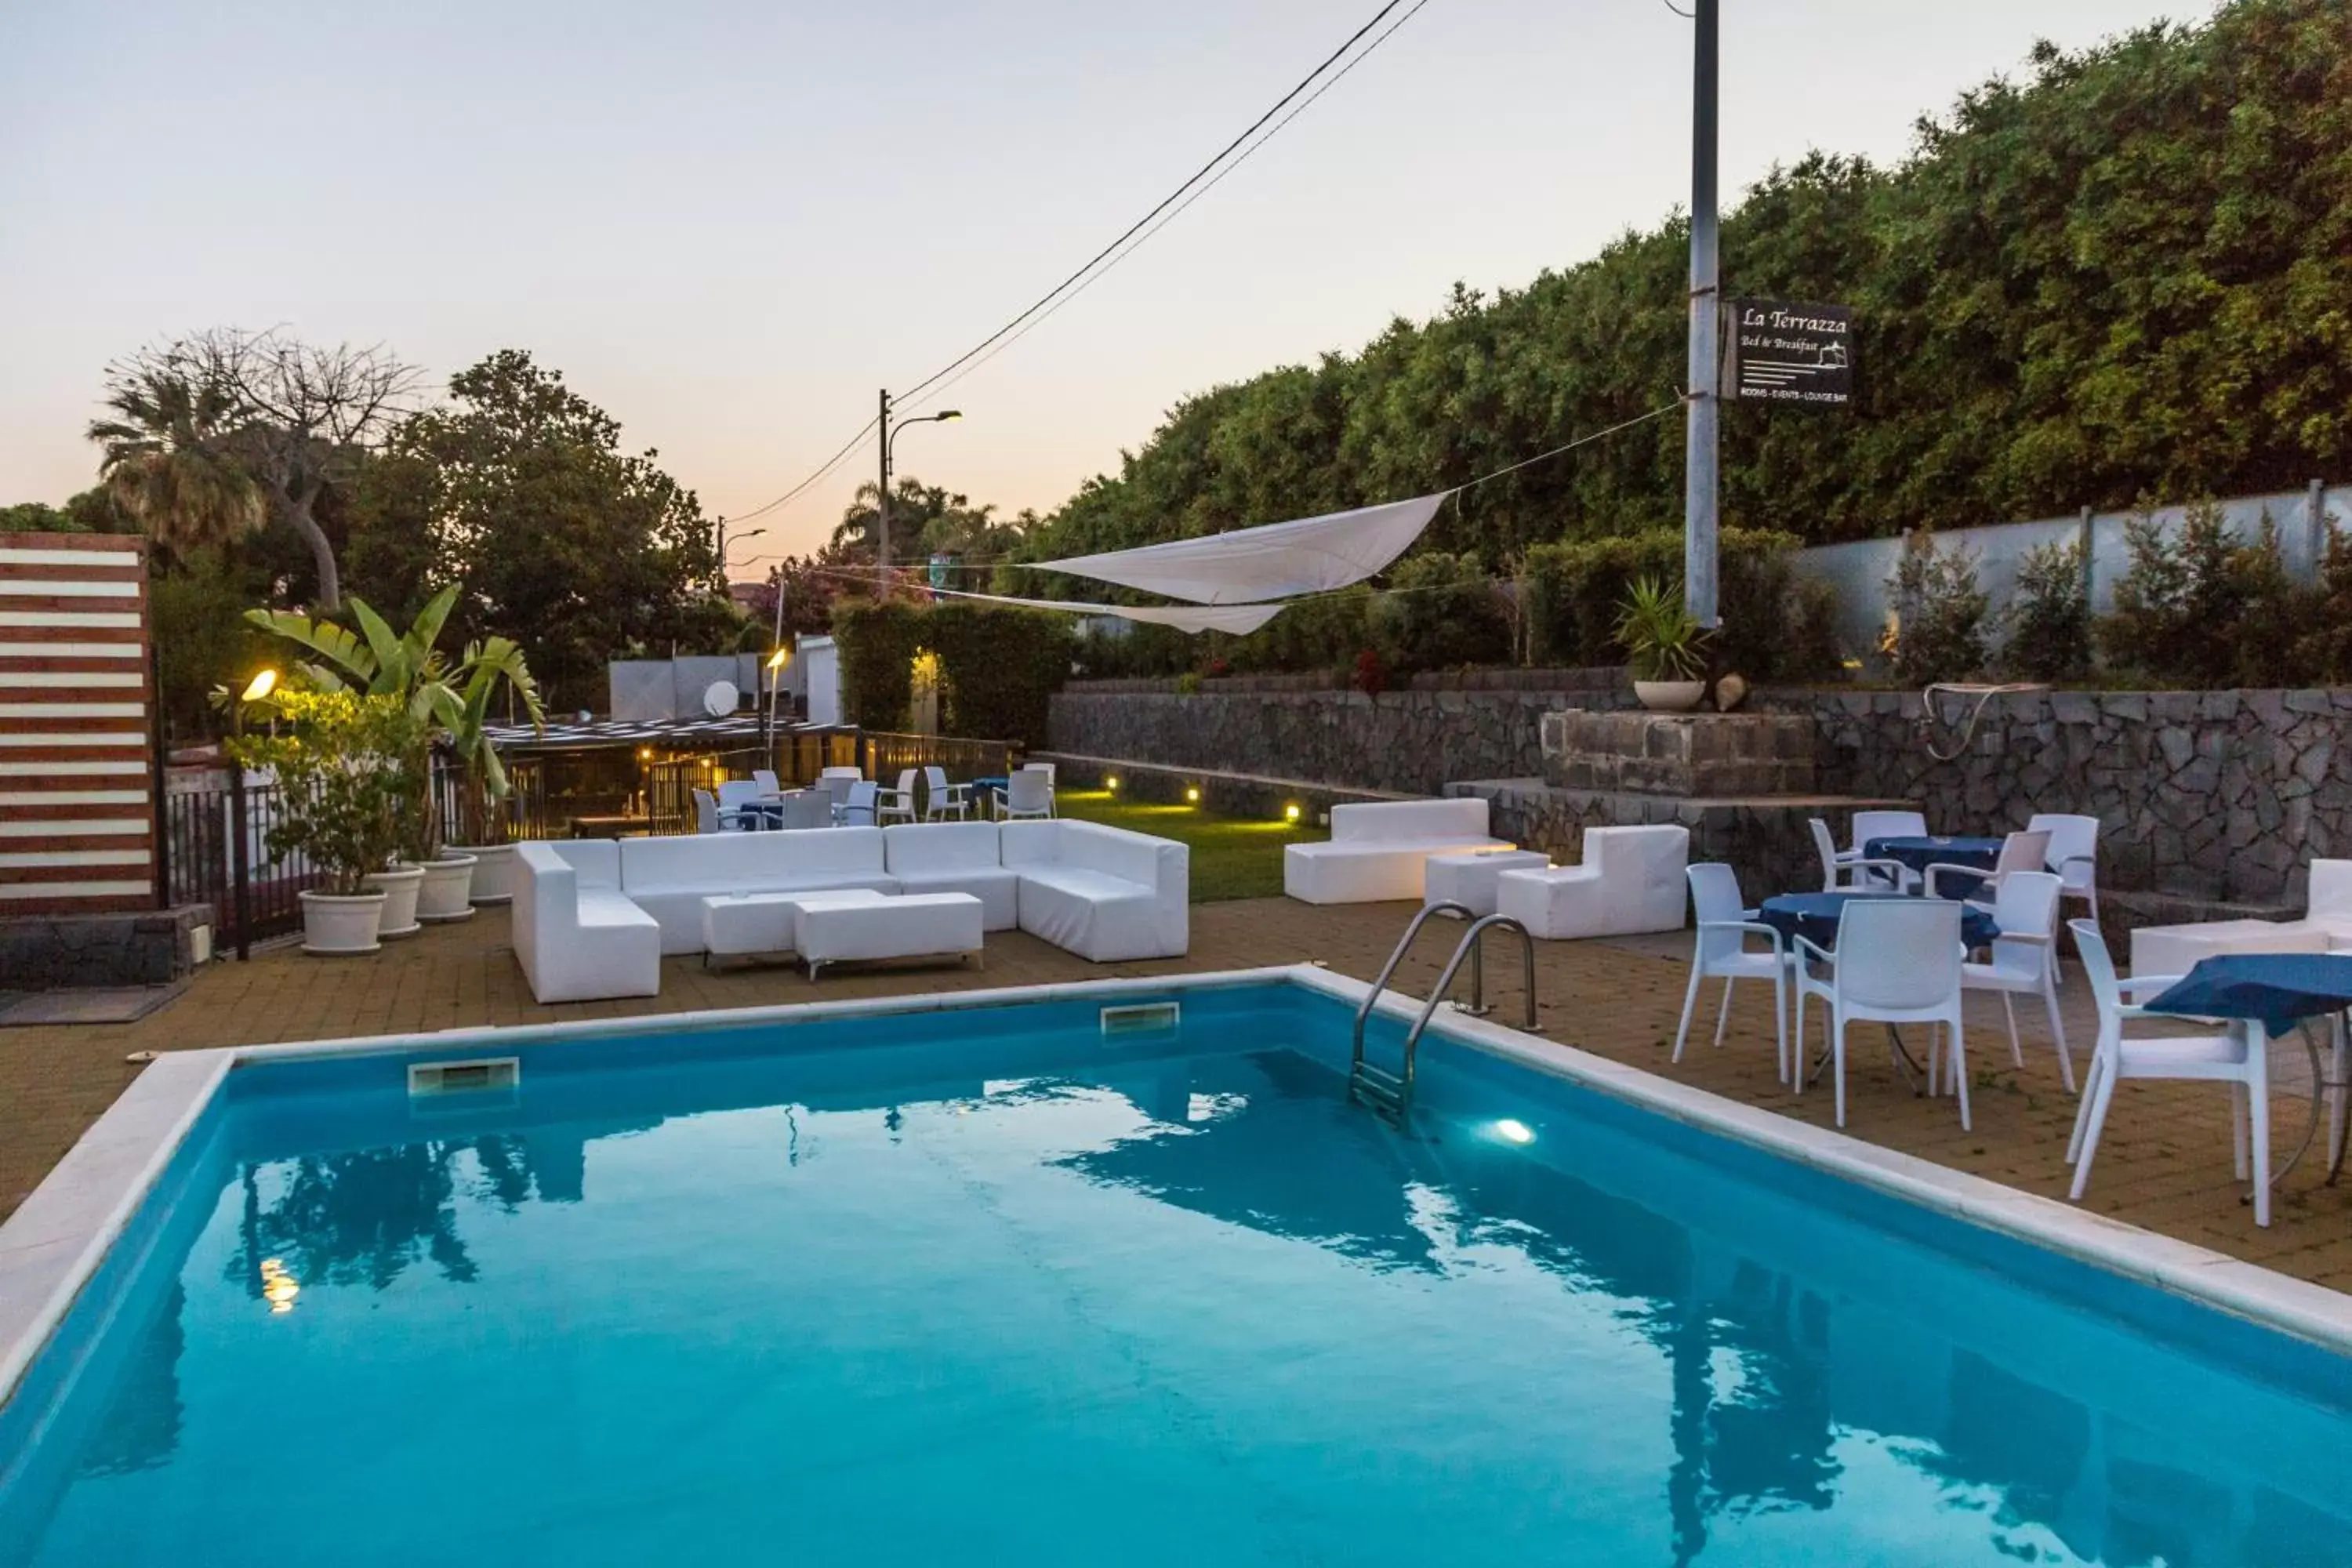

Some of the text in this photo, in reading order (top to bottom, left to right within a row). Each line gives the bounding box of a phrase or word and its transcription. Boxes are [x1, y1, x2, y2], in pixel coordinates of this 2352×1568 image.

[1743, 307, 1847, 333] La Terrazza
[1741, 334, 1762, 346] Bed
